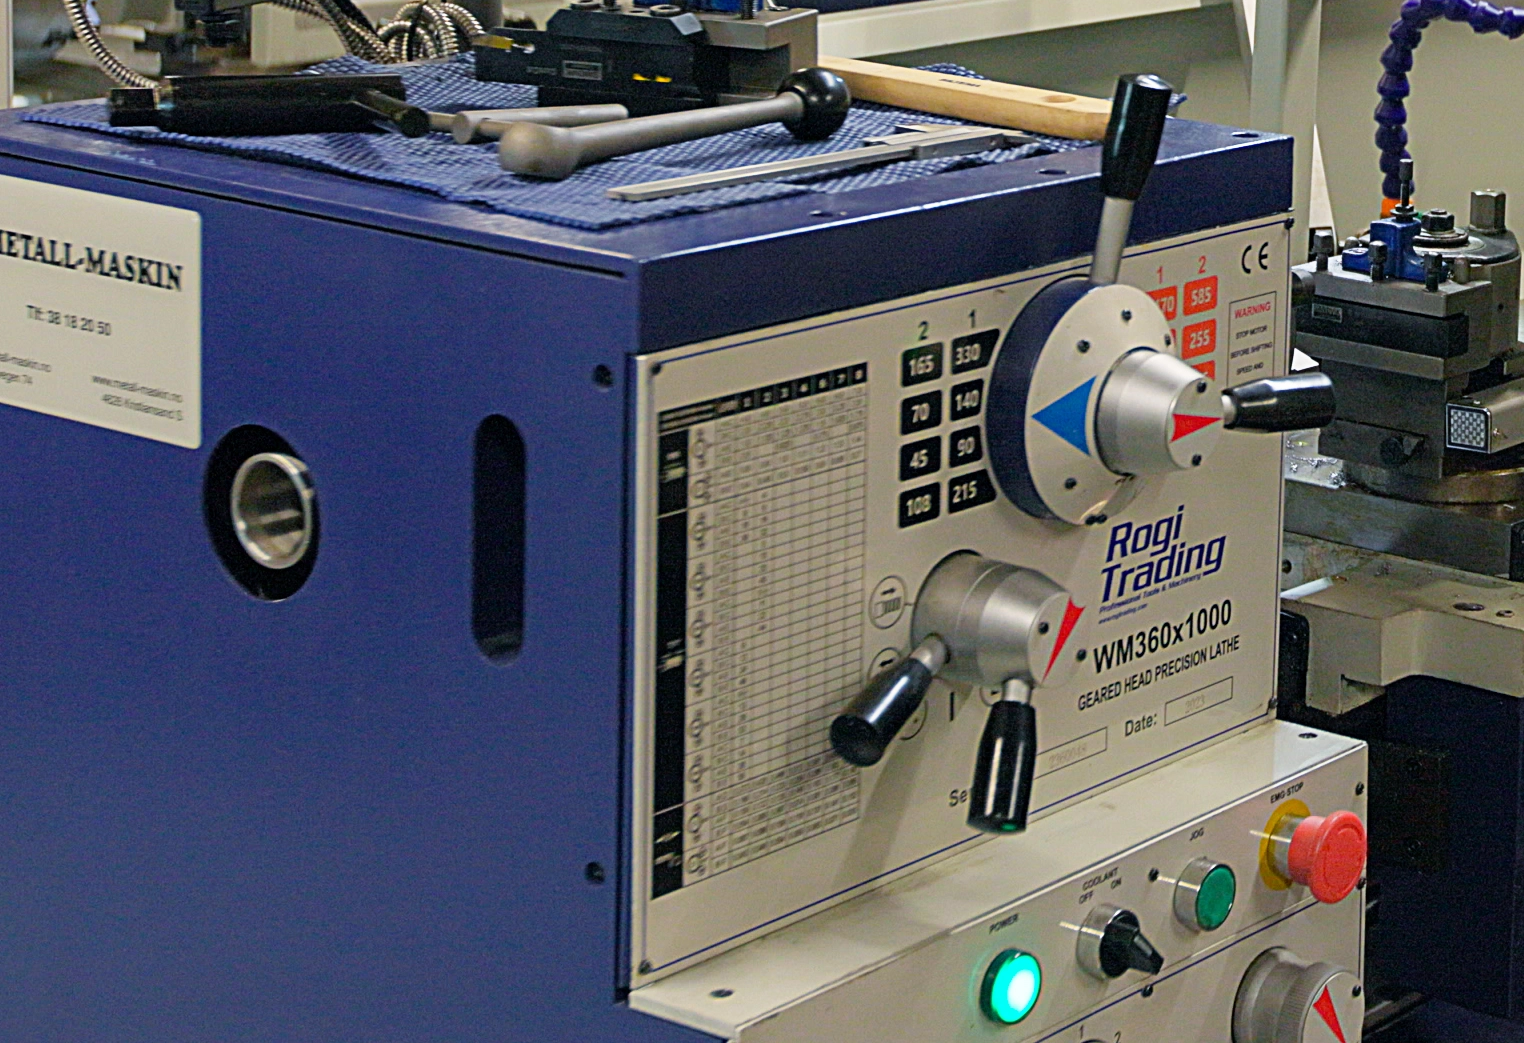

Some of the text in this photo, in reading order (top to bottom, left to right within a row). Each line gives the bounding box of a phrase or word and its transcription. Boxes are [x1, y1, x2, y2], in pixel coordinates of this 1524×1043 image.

[1198, 255, 1207, 274] 2
[1241, 242, 1269, 274] CE
[1157, 266, 1164, 284] 1
[1190, 286, 1213, 307] 585
[969, 310, 977, 328] 1
[1234, 301, 1271, 319] WARNING
[80, 317, 94, 332] 20
[97, 321, 112, 336] 50
[917, 321, 930, 341] 2
[1189, 329, 1211, 350] 255
[955, 343, 982, 365] 330
[955, 389, 980, 411] 140
[911, 402, 930, 423] 70
[957, 436, 976, 457] 90
[909, 449, 929, 469] 45
[952, 480, 978, 504] 215
[1105, 504, 1185, 563] Rogi
[1101, 535, 1227, 603] Trading
[1093, 599, 1232, 674] WM360x1000
[1078, 635, 1240, 711] GEARED HEAD PRECISION LATHE
[1124, 713, 1158, 738] Date:
[1082, 867, 1119, 891] COOLANT
[1078, 890, 1094, 905] OFF
[989, 913, 1019, 935] POWER
[1079, 1024, 1084, 1041] 1
